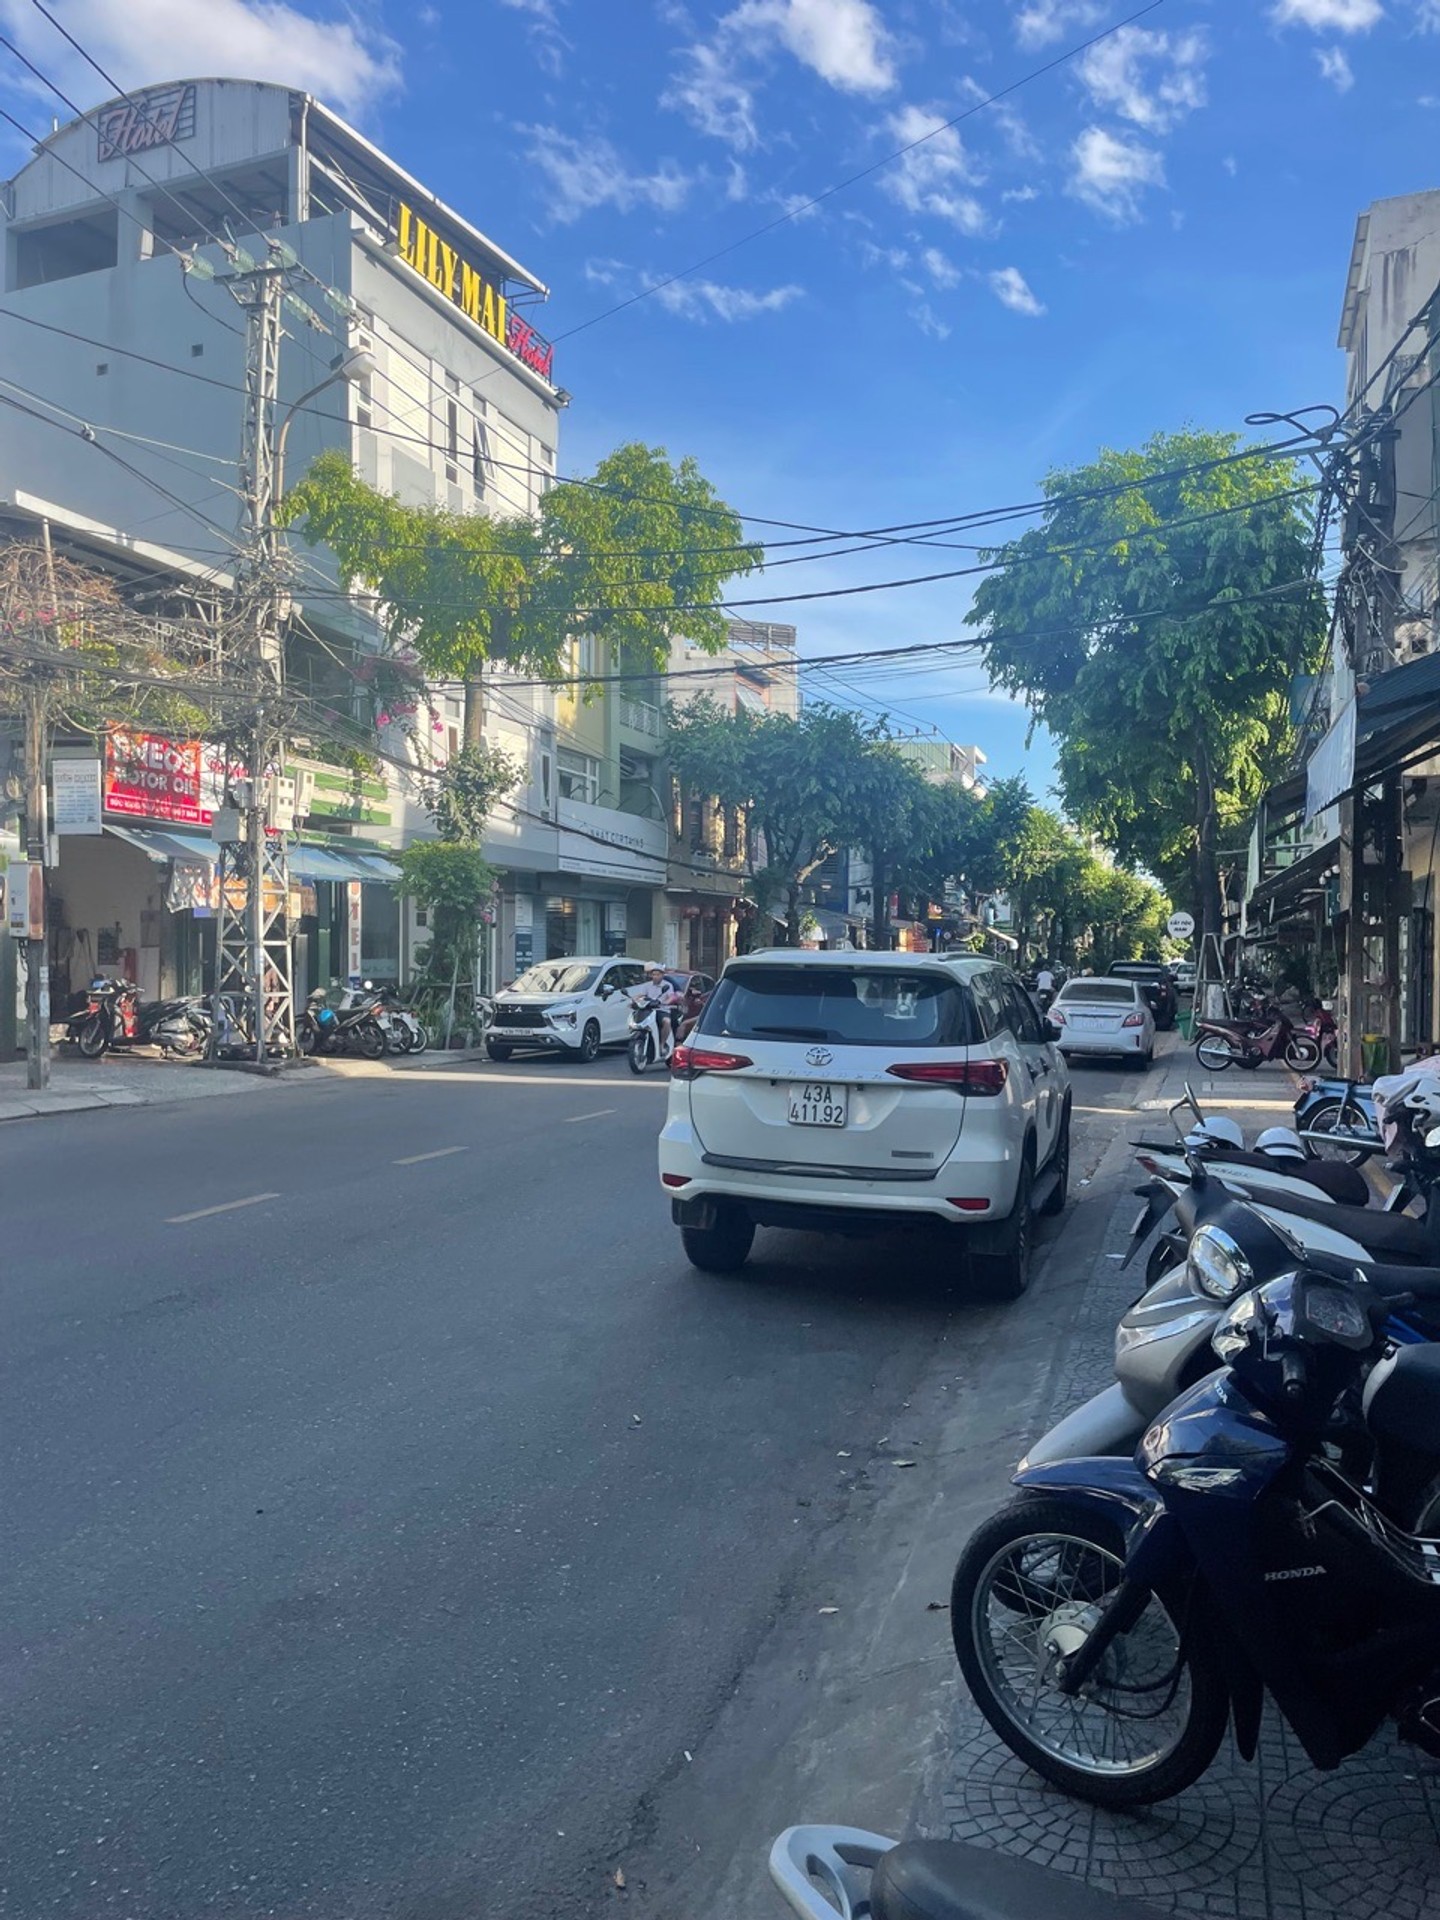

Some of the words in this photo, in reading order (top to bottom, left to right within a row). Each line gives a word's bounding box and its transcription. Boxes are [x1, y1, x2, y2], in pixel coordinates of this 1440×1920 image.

[100, 86, 187, 161] Hotel
[399, 202, 459, 301] LILY
[460, 260, 507, 347] MAI
[506, 315, 554, 377] Hotel
[172, 777, 196, 797] OIL
[803, 1084, 833, 1103] 43A
[790, 1104, 844, 1124] 411.92
[1264, 1565, 1327, 1581] HONDA
